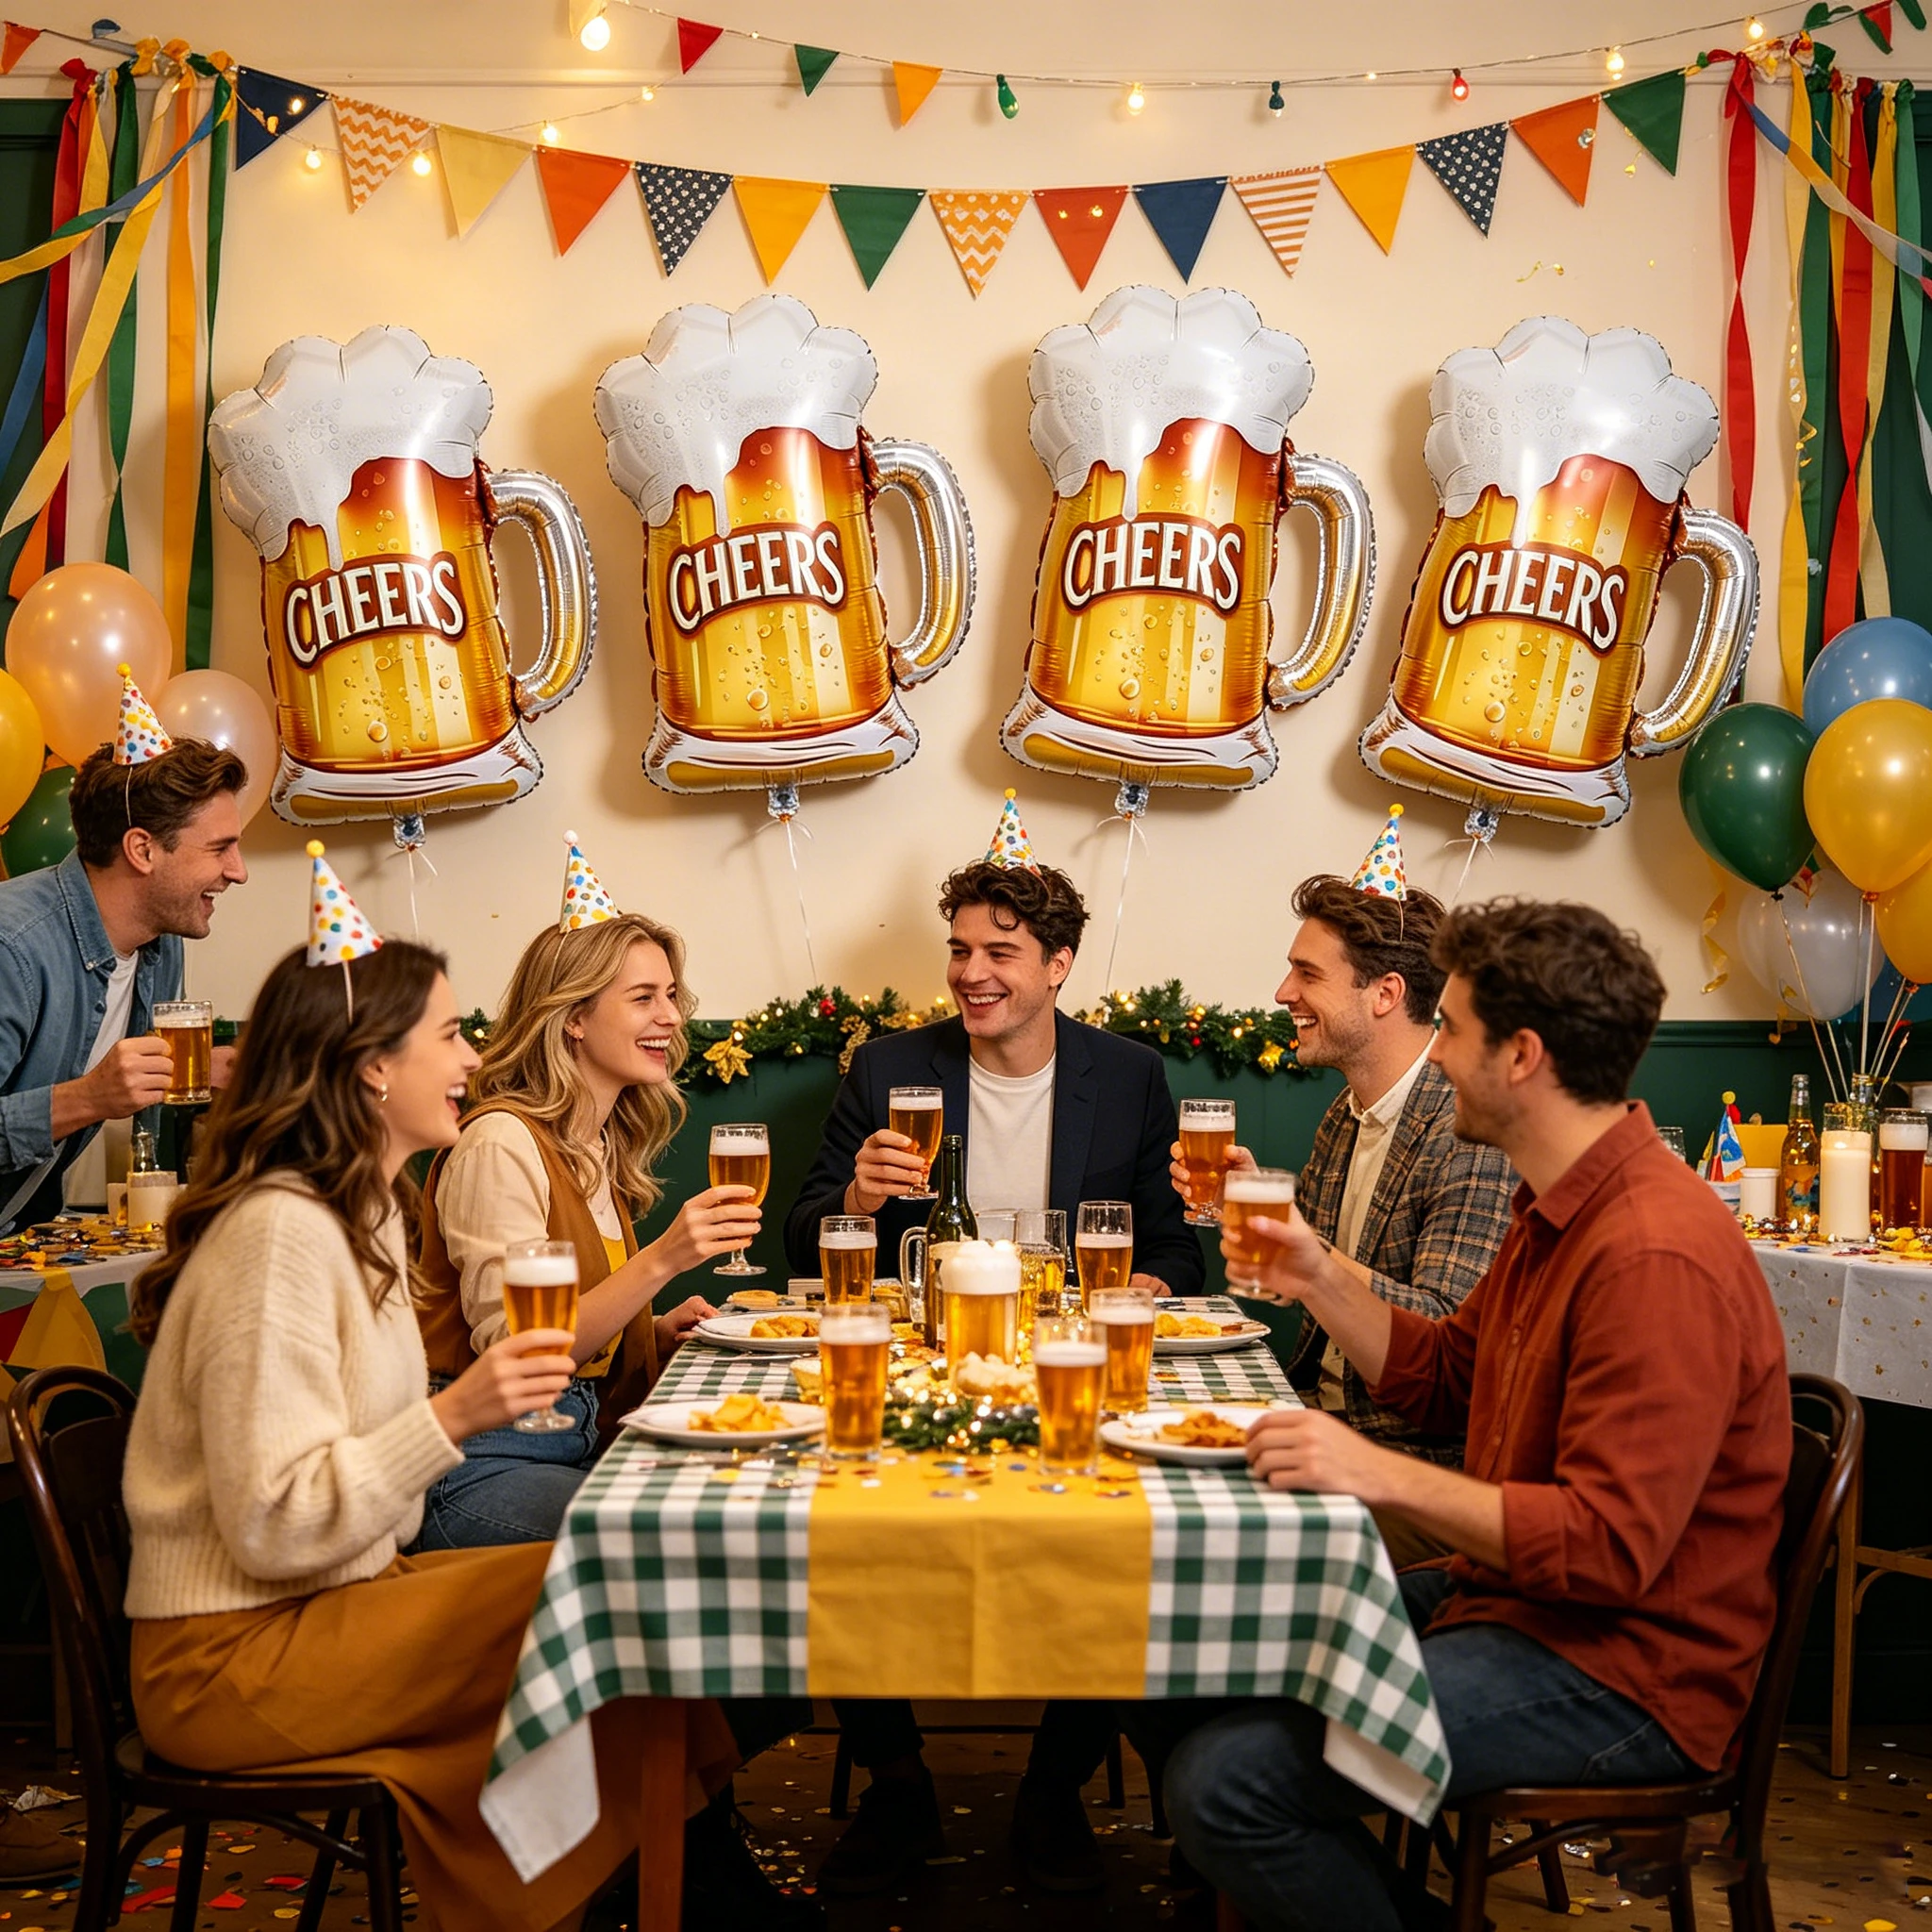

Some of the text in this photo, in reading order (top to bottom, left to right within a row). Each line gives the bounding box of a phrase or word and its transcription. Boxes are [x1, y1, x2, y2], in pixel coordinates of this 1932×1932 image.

[287, 560, 464, 662] CHEERS
[670, 530, 844, 630] CHEERS
[1064, 522, 1241, 609] CHEERS
[1442, 549, 1624, 650] CHEERS
